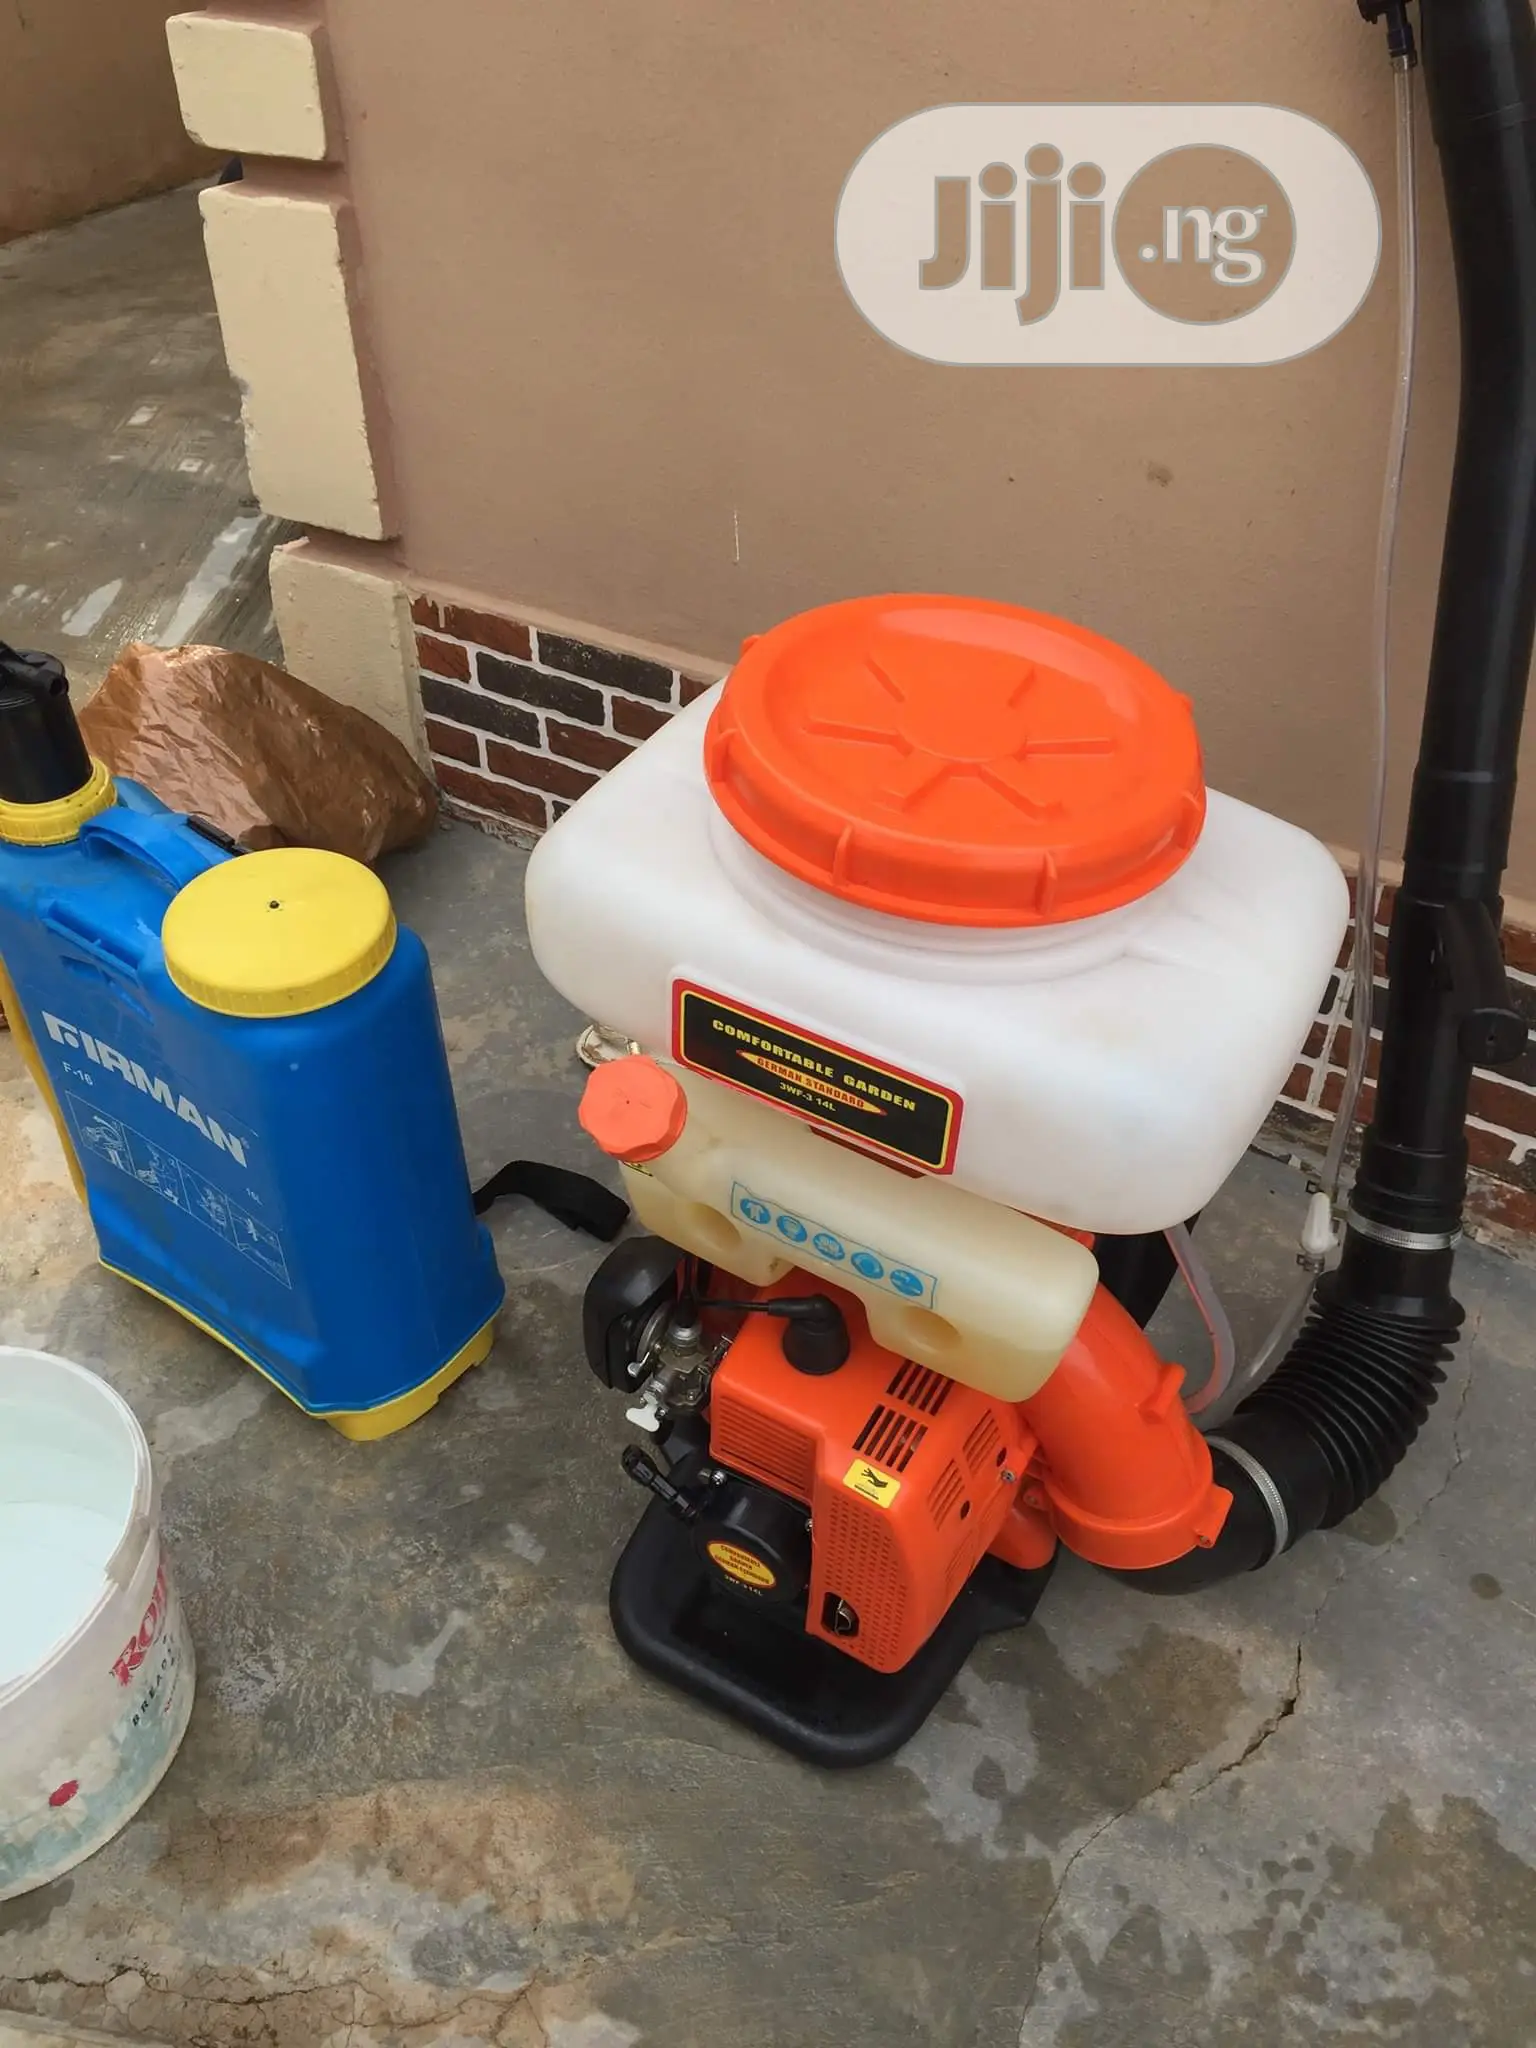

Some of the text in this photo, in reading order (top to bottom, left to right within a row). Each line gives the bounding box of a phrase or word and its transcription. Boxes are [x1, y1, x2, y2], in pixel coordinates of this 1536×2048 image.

[41, 1011, 247, 1168] FIRMAN
[712, 1019, 916, 1112] COMFORTABLE GARDEN
[756, 1057, 865, 1109] GERMAN STANDARD
